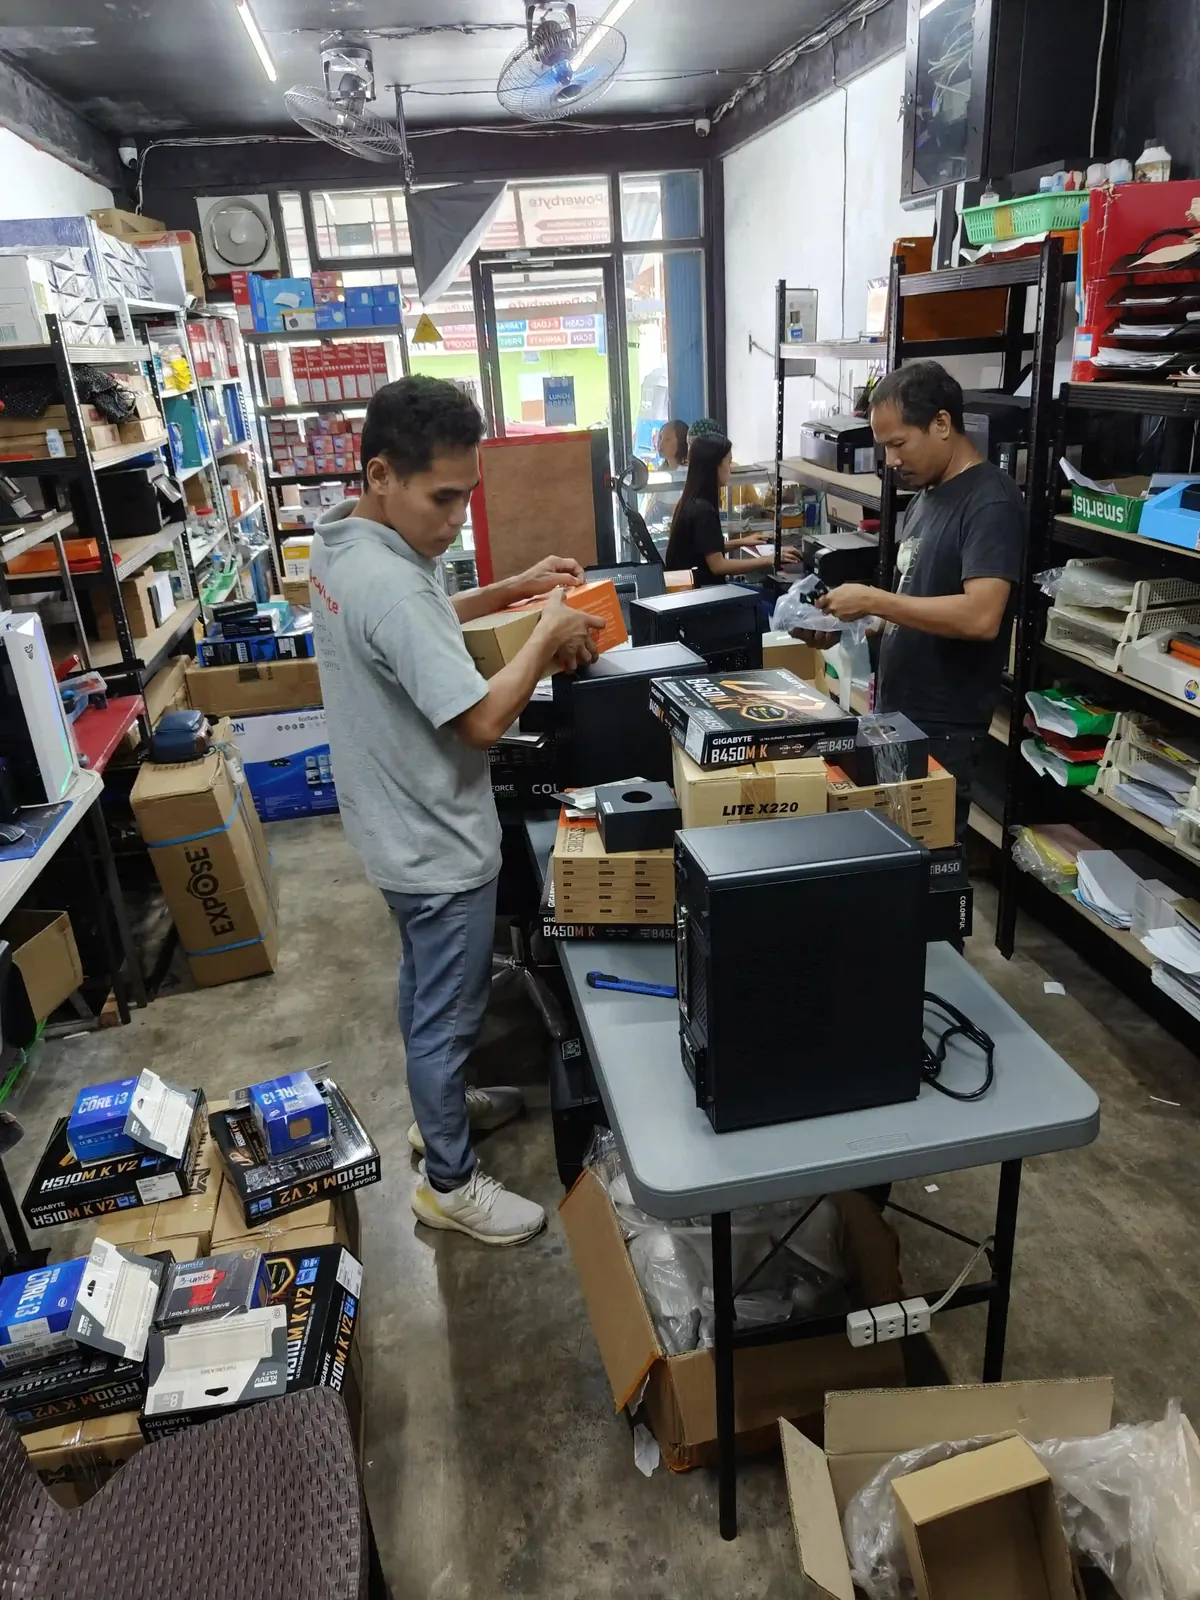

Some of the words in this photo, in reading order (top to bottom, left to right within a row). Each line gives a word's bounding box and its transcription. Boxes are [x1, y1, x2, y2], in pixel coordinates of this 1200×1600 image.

[1072, 494, 1125, 523] smartist
[712, 735, 754, 745] GIGABYTE
[829, 739, 854, 752] B450
[711, 745, 756, 763] B450M
[760, 744, 768, 758] K
[722, 804, 755, 816] LITE
[757, 802, 799, 814] X220
[934, 862, 960, 874] B450
[959, 895, 967, 930] COLORFUL
[543, 925, 584, 937] B450M
[588, 925, 596, 937] K
[78, 1095, 114, 1114] CORE
[114, 1092, 129, 1106] i3
[40, 1169, 97, 1190] H510M
[100, 1165, 112, 1177] K
[117, 1160, 138, 1173] V2
[323, 1161, 377, 1185] H510M
[306, 1181, 318, 1194] K
[341, 1175, 378, 1192] GIGABYTE
[279, 1187, 303, 1204] V2
[30, 1201, 66, 1213] GIGABYTE
[33, 1207, 80, 1226] H510M
[84, 1203, 94, 1216] K
[96, 1200, 117, 1212] V2
[175, 1259, 205, 1272] Ramsta
[19, 1270, 52, 1306] CORE
[294, 1286, 315, 1309] V2
[171, 1309, 190, 1318] SOLID
[191, 1306, 210, 1314] STATE
[211, 1302, 230, 1311] DRIVE
[290, 1310, 309, 1323] K
[341, 1315, 353, 1335] V2
[339, 1337, 349, 1350] K
[79, 1381, 140, 1402] H510M
[65, 1400, 76, 1411] K
[100, 1393, 143, 1410] GIGABYTE
[35, 1404, 61, 1416] V2
[144, 1416, 192, 1429] GIGABYTE
